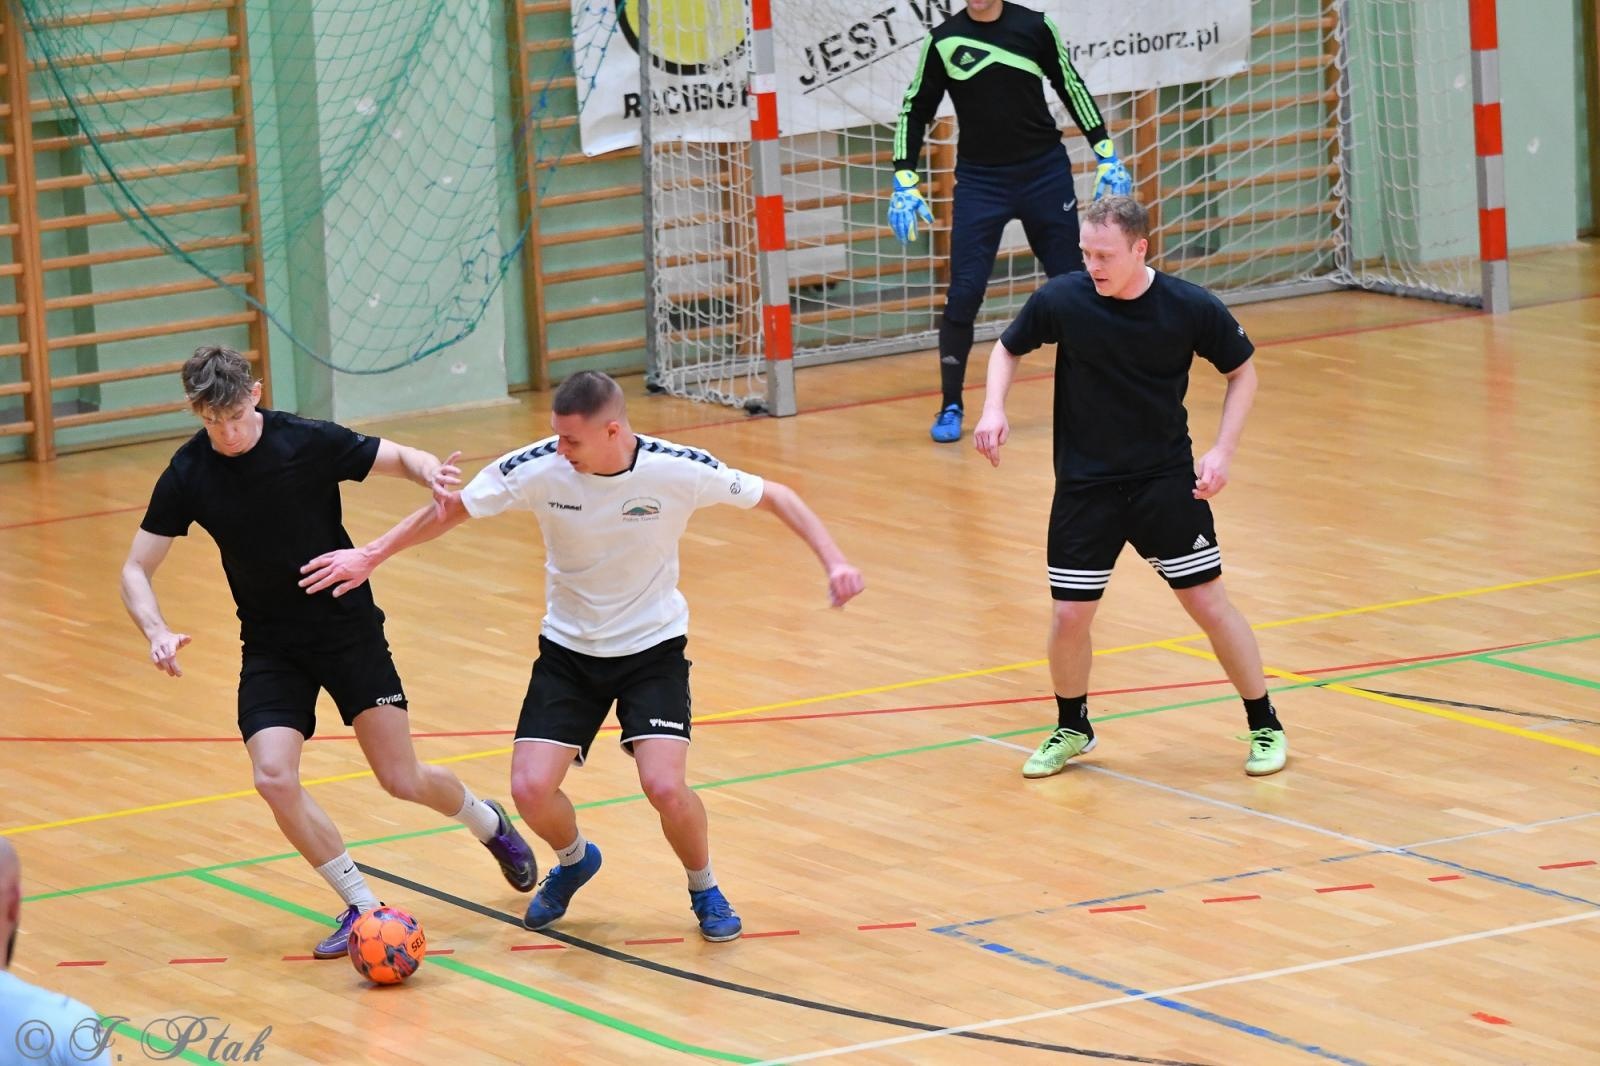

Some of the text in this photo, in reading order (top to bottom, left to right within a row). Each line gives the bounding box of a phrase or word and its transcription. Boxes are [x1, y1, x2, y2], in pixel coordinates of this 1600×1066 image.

[799, 6, 897, 86] JEST
[1066, 21, 1220, 62] ir-raciborz.pl
[658, 718, 684, 731] hummel
